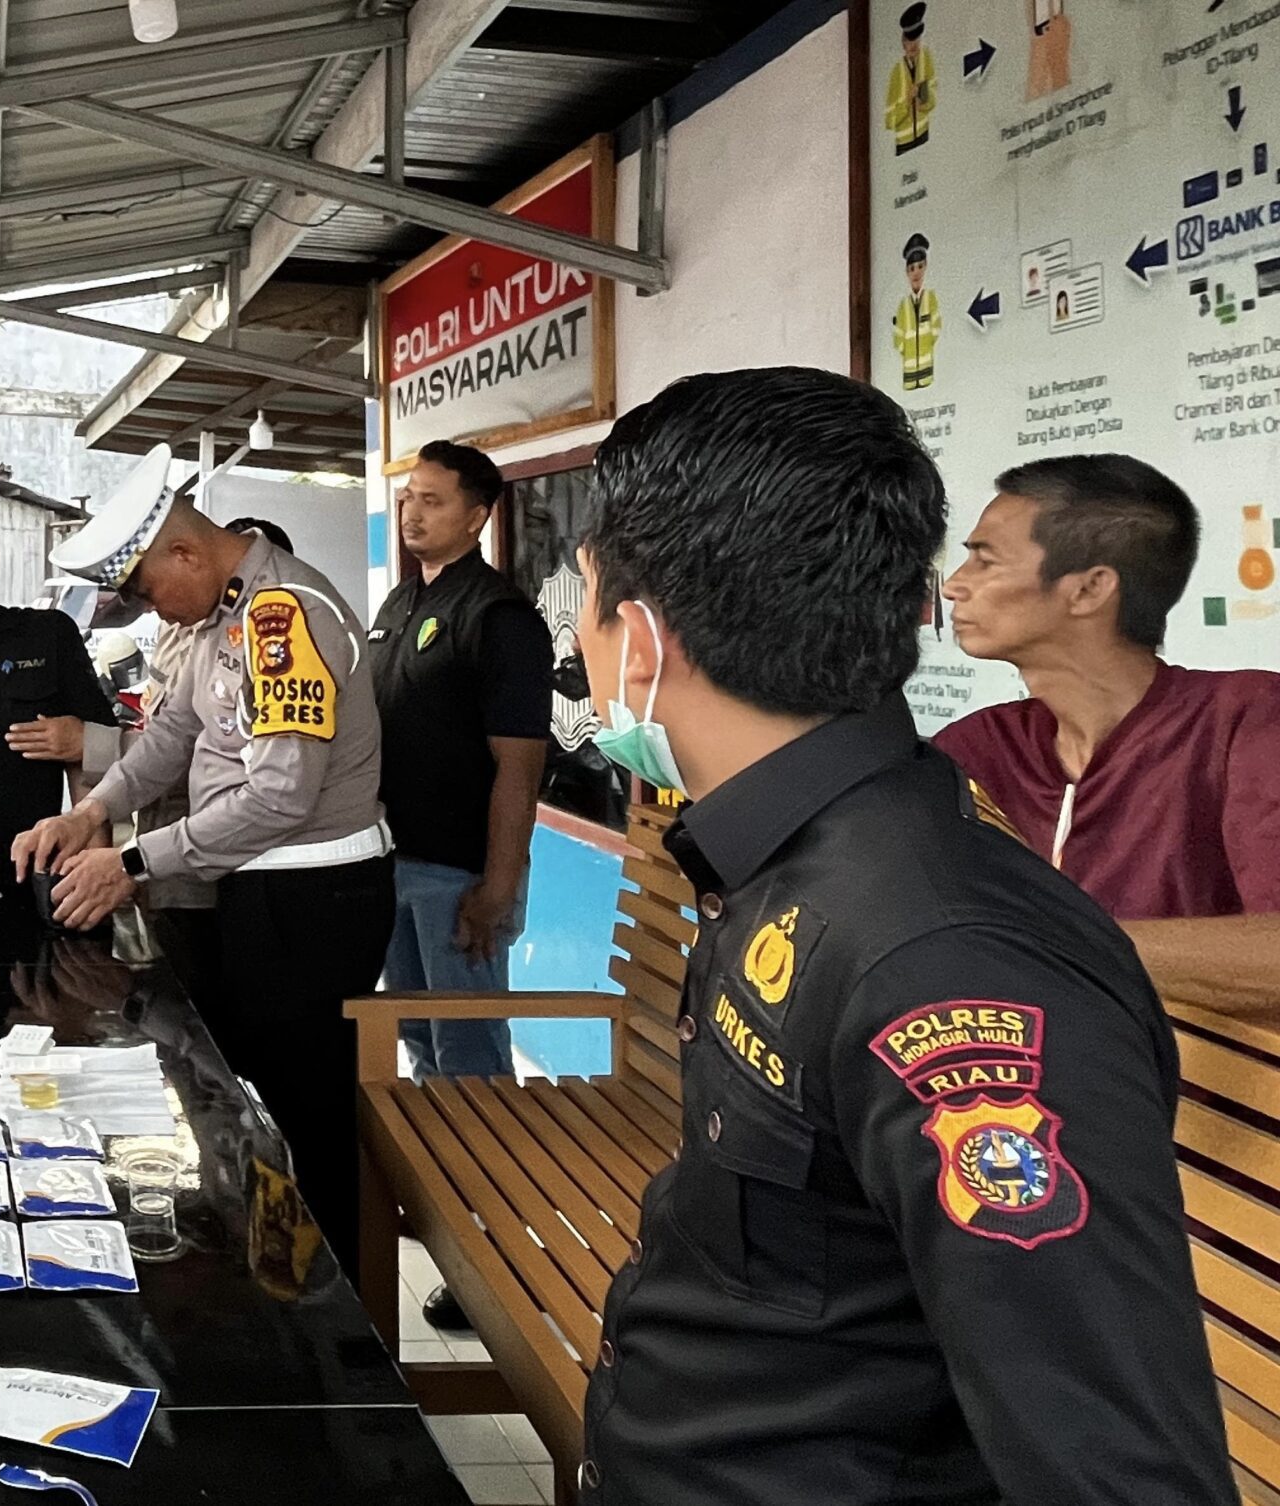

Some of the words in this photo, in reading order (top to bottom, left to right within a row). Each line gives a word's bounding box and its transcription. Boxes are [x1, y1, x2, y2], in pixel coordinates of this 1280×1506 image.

[1207, 204, 1265, 242] BANK
[393, 305, 460, 372] POLRI
[469, 261, 587, 336] UNTUK
[396, 306, 587, 420] MASYARAKAT
[1188, 343, 1260, 368] Pembayaran
[1199, 372, 1234, 392] Tilang
[1175, 396, 1222, 421] Channel
[1247, 391, 1271, 409] dan
[1193, 426, 1227, 443] Antar
[1229, 418, 1261, 438] Bank
[262, 678, 325, 703] POSKO
[283, 703, 325, 725] RES
[715, 993, 785, 1087] URKES
[887, 1008, 1024, 1053] POLRES
[900, 1028, 972, 1065] INDRAGIRI
[977, 1028, 1024, 1048] HULU
[928, 1065, 1019, 1093] RIAU
